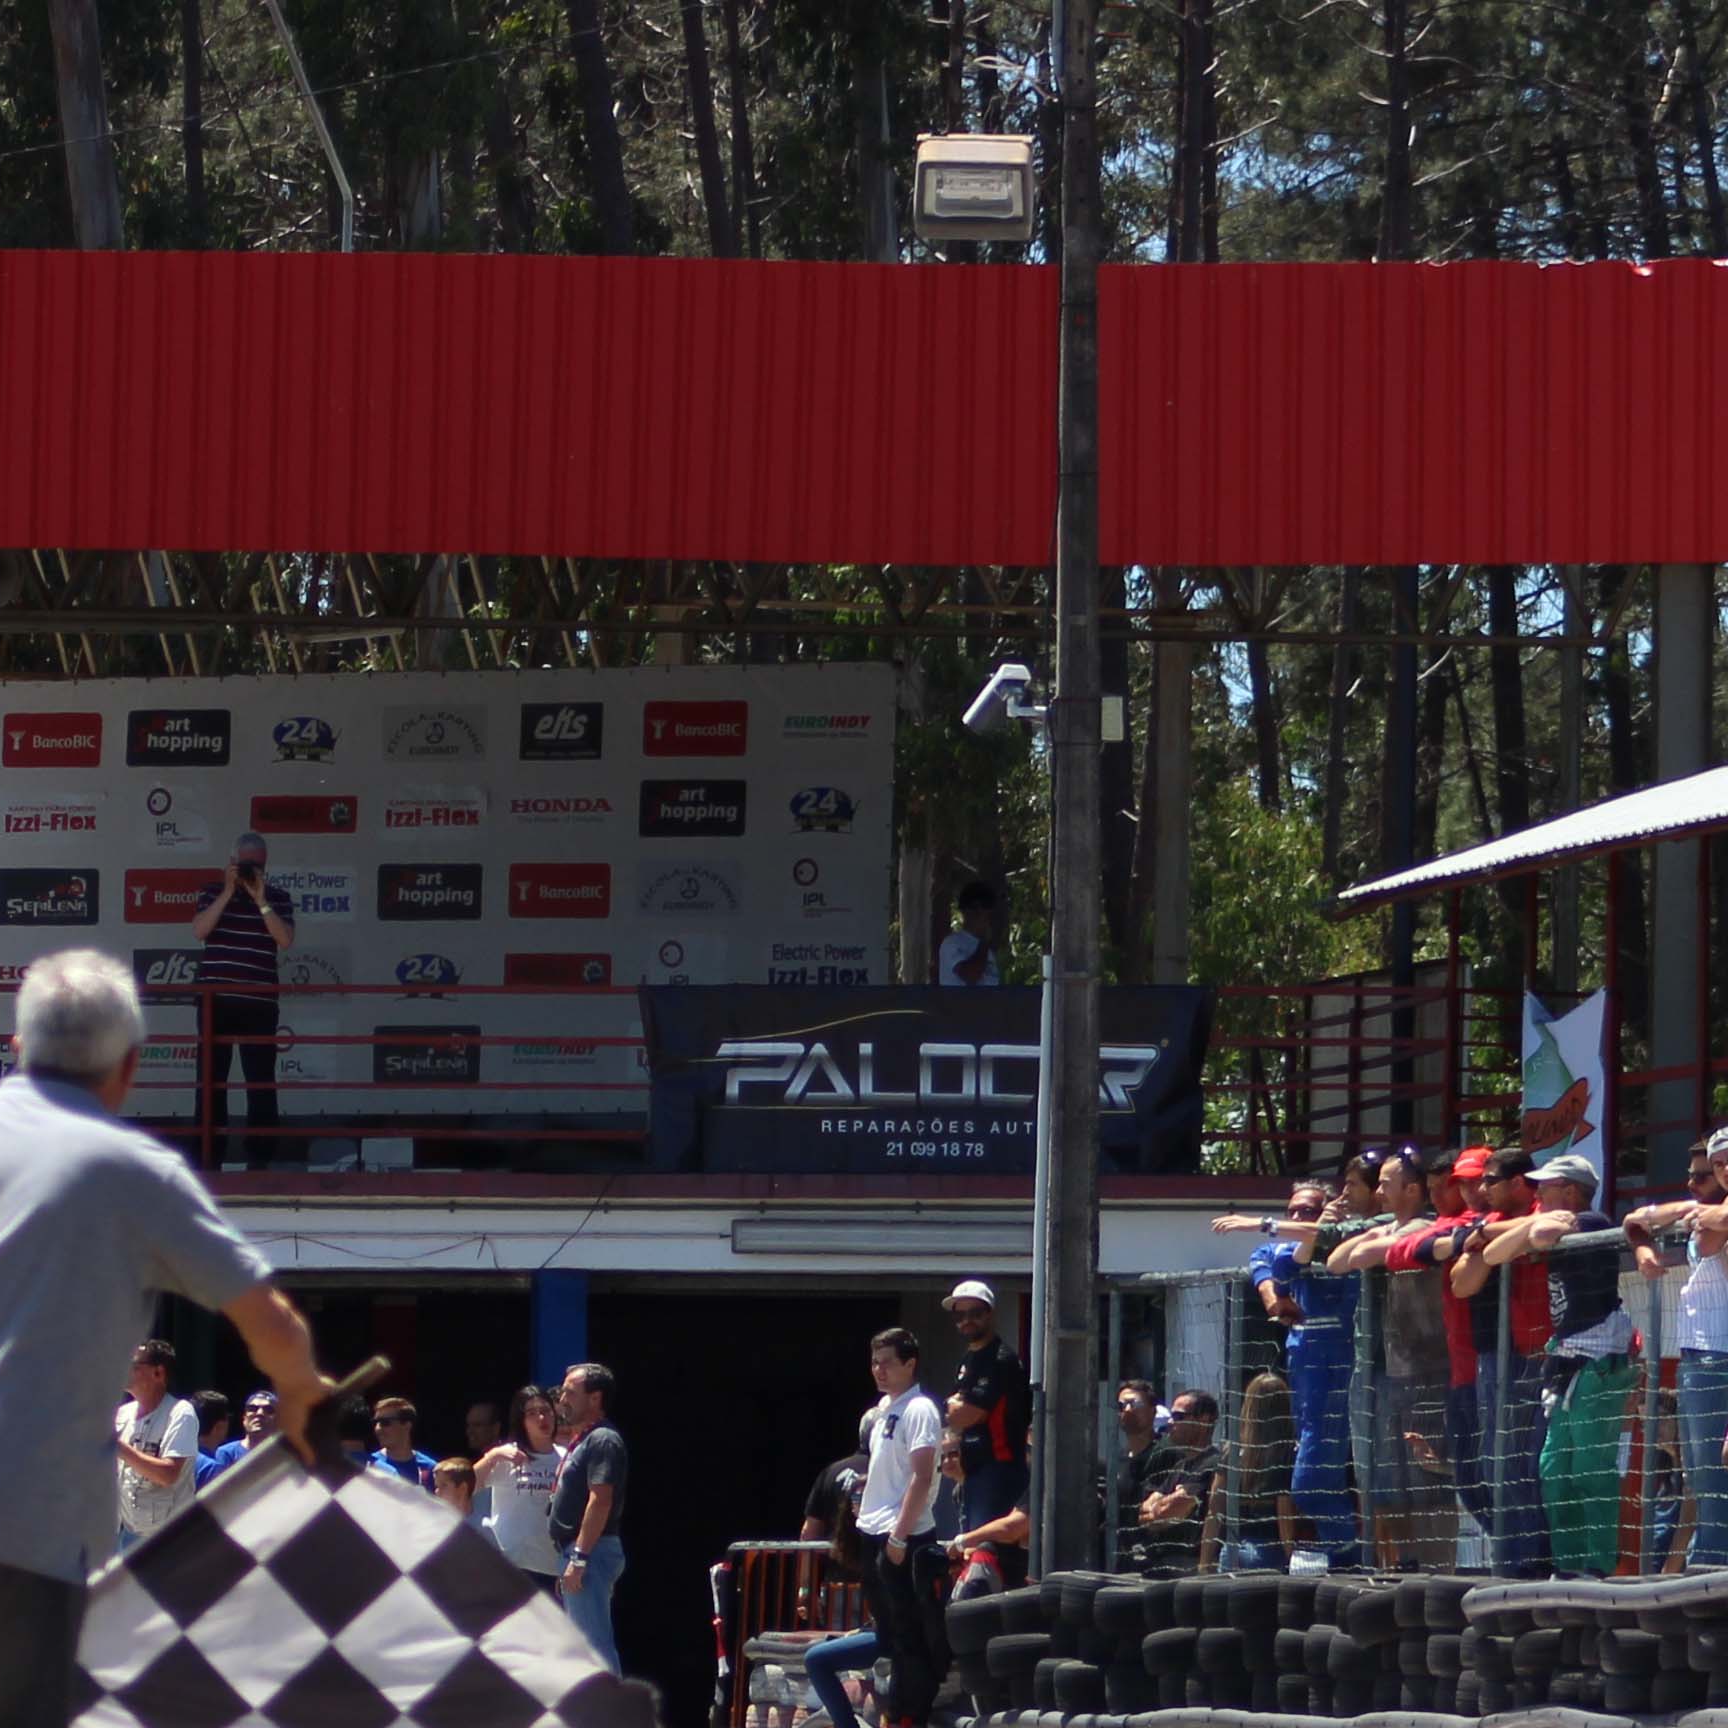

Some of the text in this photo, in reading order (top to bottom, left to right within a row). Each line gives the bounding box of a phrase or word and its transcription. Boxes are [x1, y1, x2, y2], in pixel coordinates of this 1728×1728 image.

[152, 714, 191, 732] art
[281, 719, 319, 744] 24
[137, 733, 223, 752] hopping
[510, 799, 614, 813] HONDA
[649, 802, 738, 823] hopping
[799, 791, 837, 815] 24
[155, 821, 179, 836] IPL
[308, 872, 349, 889] Power
[387, 887, 475, 906] hopping
[802, 892, 828, 907] IPL
[771, 944, 867, 960] Electric Power
[405, 957, 443, 981] 24
[280, 1058, 304, 1074] IPL
[717, 1041, 1160, 1107] PALOCR
[821, 1116, 1036, 1135] REPARAÇÕES AUT
